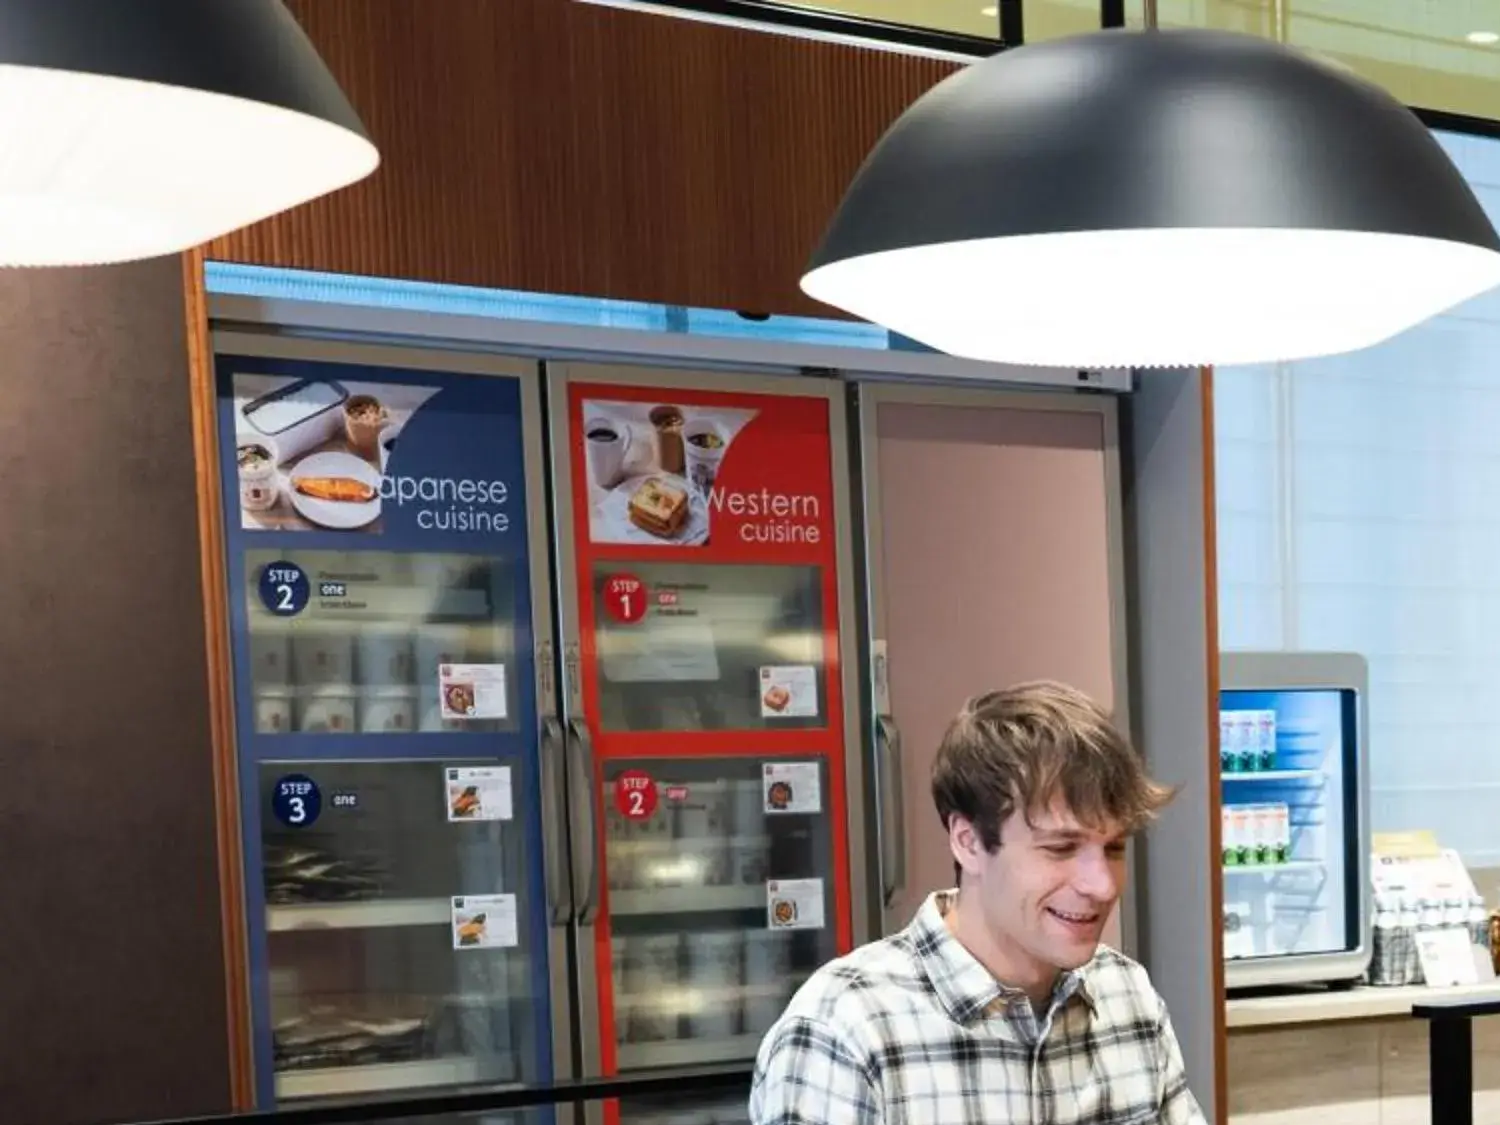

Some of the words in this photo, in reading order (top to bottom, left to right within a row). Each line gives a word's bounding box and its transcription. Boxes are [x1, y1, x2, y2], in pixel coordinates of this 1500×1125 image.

[701, 486, 819, 518] Western
[417, 505, 509, 531] cuisine
[740, 519, 820, 543] cuisine
[268, 569, 300, 583] STEP
[612, 580, 640, 593] STEP
[276, 584, 295, 610] 2
[620, 594, 631, 618] 1
[281, 783, 312, 796] STEP
[622, 777, 650, 790] STEP
[288, 797, 307, 823] 3
[629, 791, 645, 815] 2
